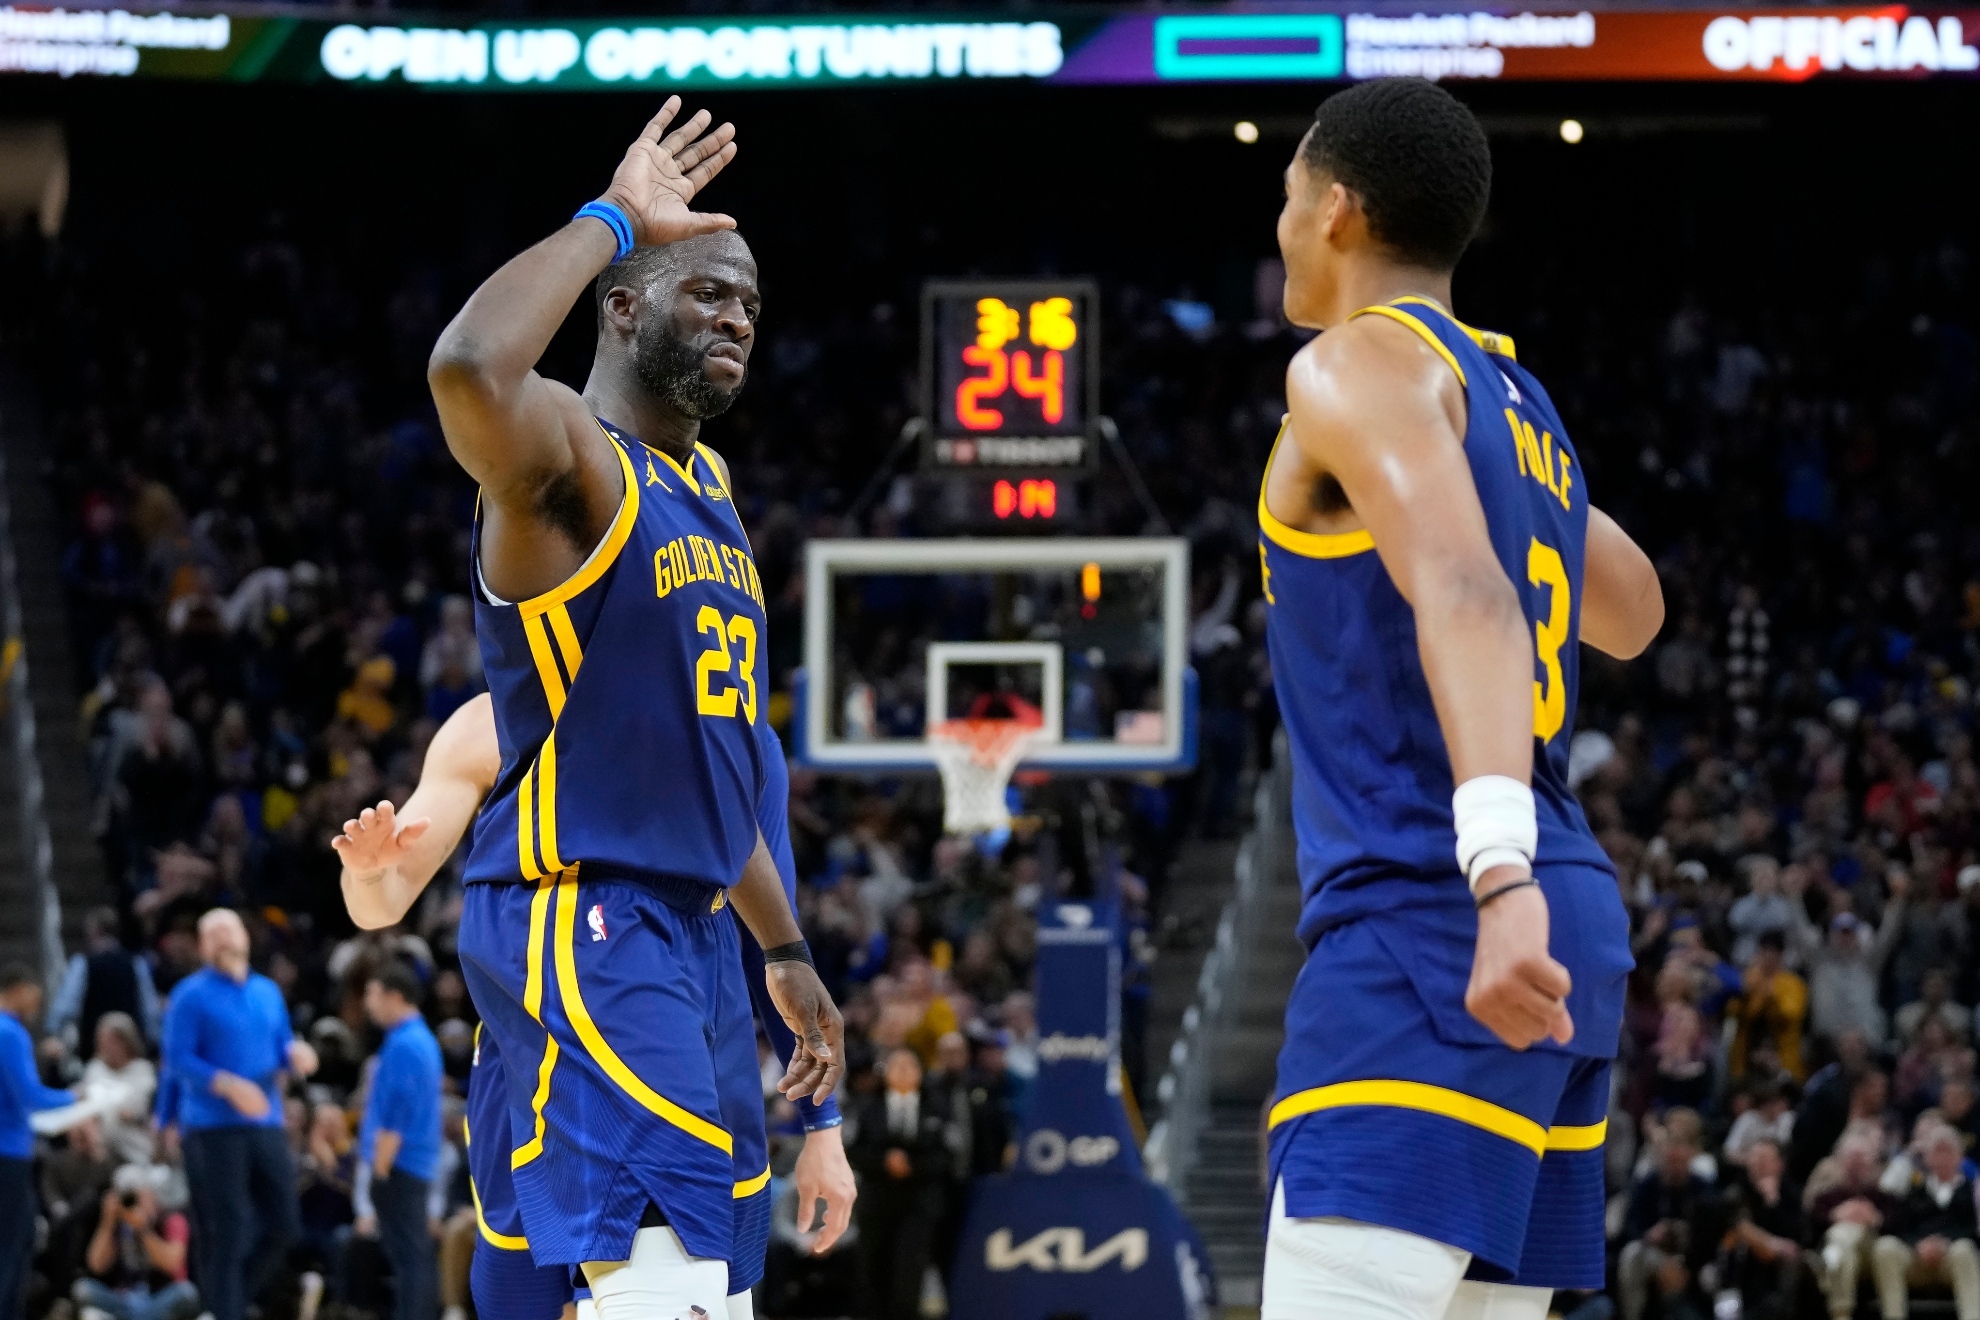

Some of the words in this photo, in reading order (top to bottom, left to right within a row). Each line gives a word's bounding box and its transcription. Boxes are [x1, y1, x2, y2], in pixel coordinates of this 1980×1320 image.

[320, 24, 488, 82] OPEN
[494, 28, 580, 82] UP
[584, 22, 1063, 80] OPPORTUNITIES
[1703, 15, 1978, 71] OFFICIAL
[956, 345, 1064, 430] 24
[654, 534, 725, 599] GOLDEN
[696, 605, 757, 726] 23
[1528, 535, 1571, 746] 3
